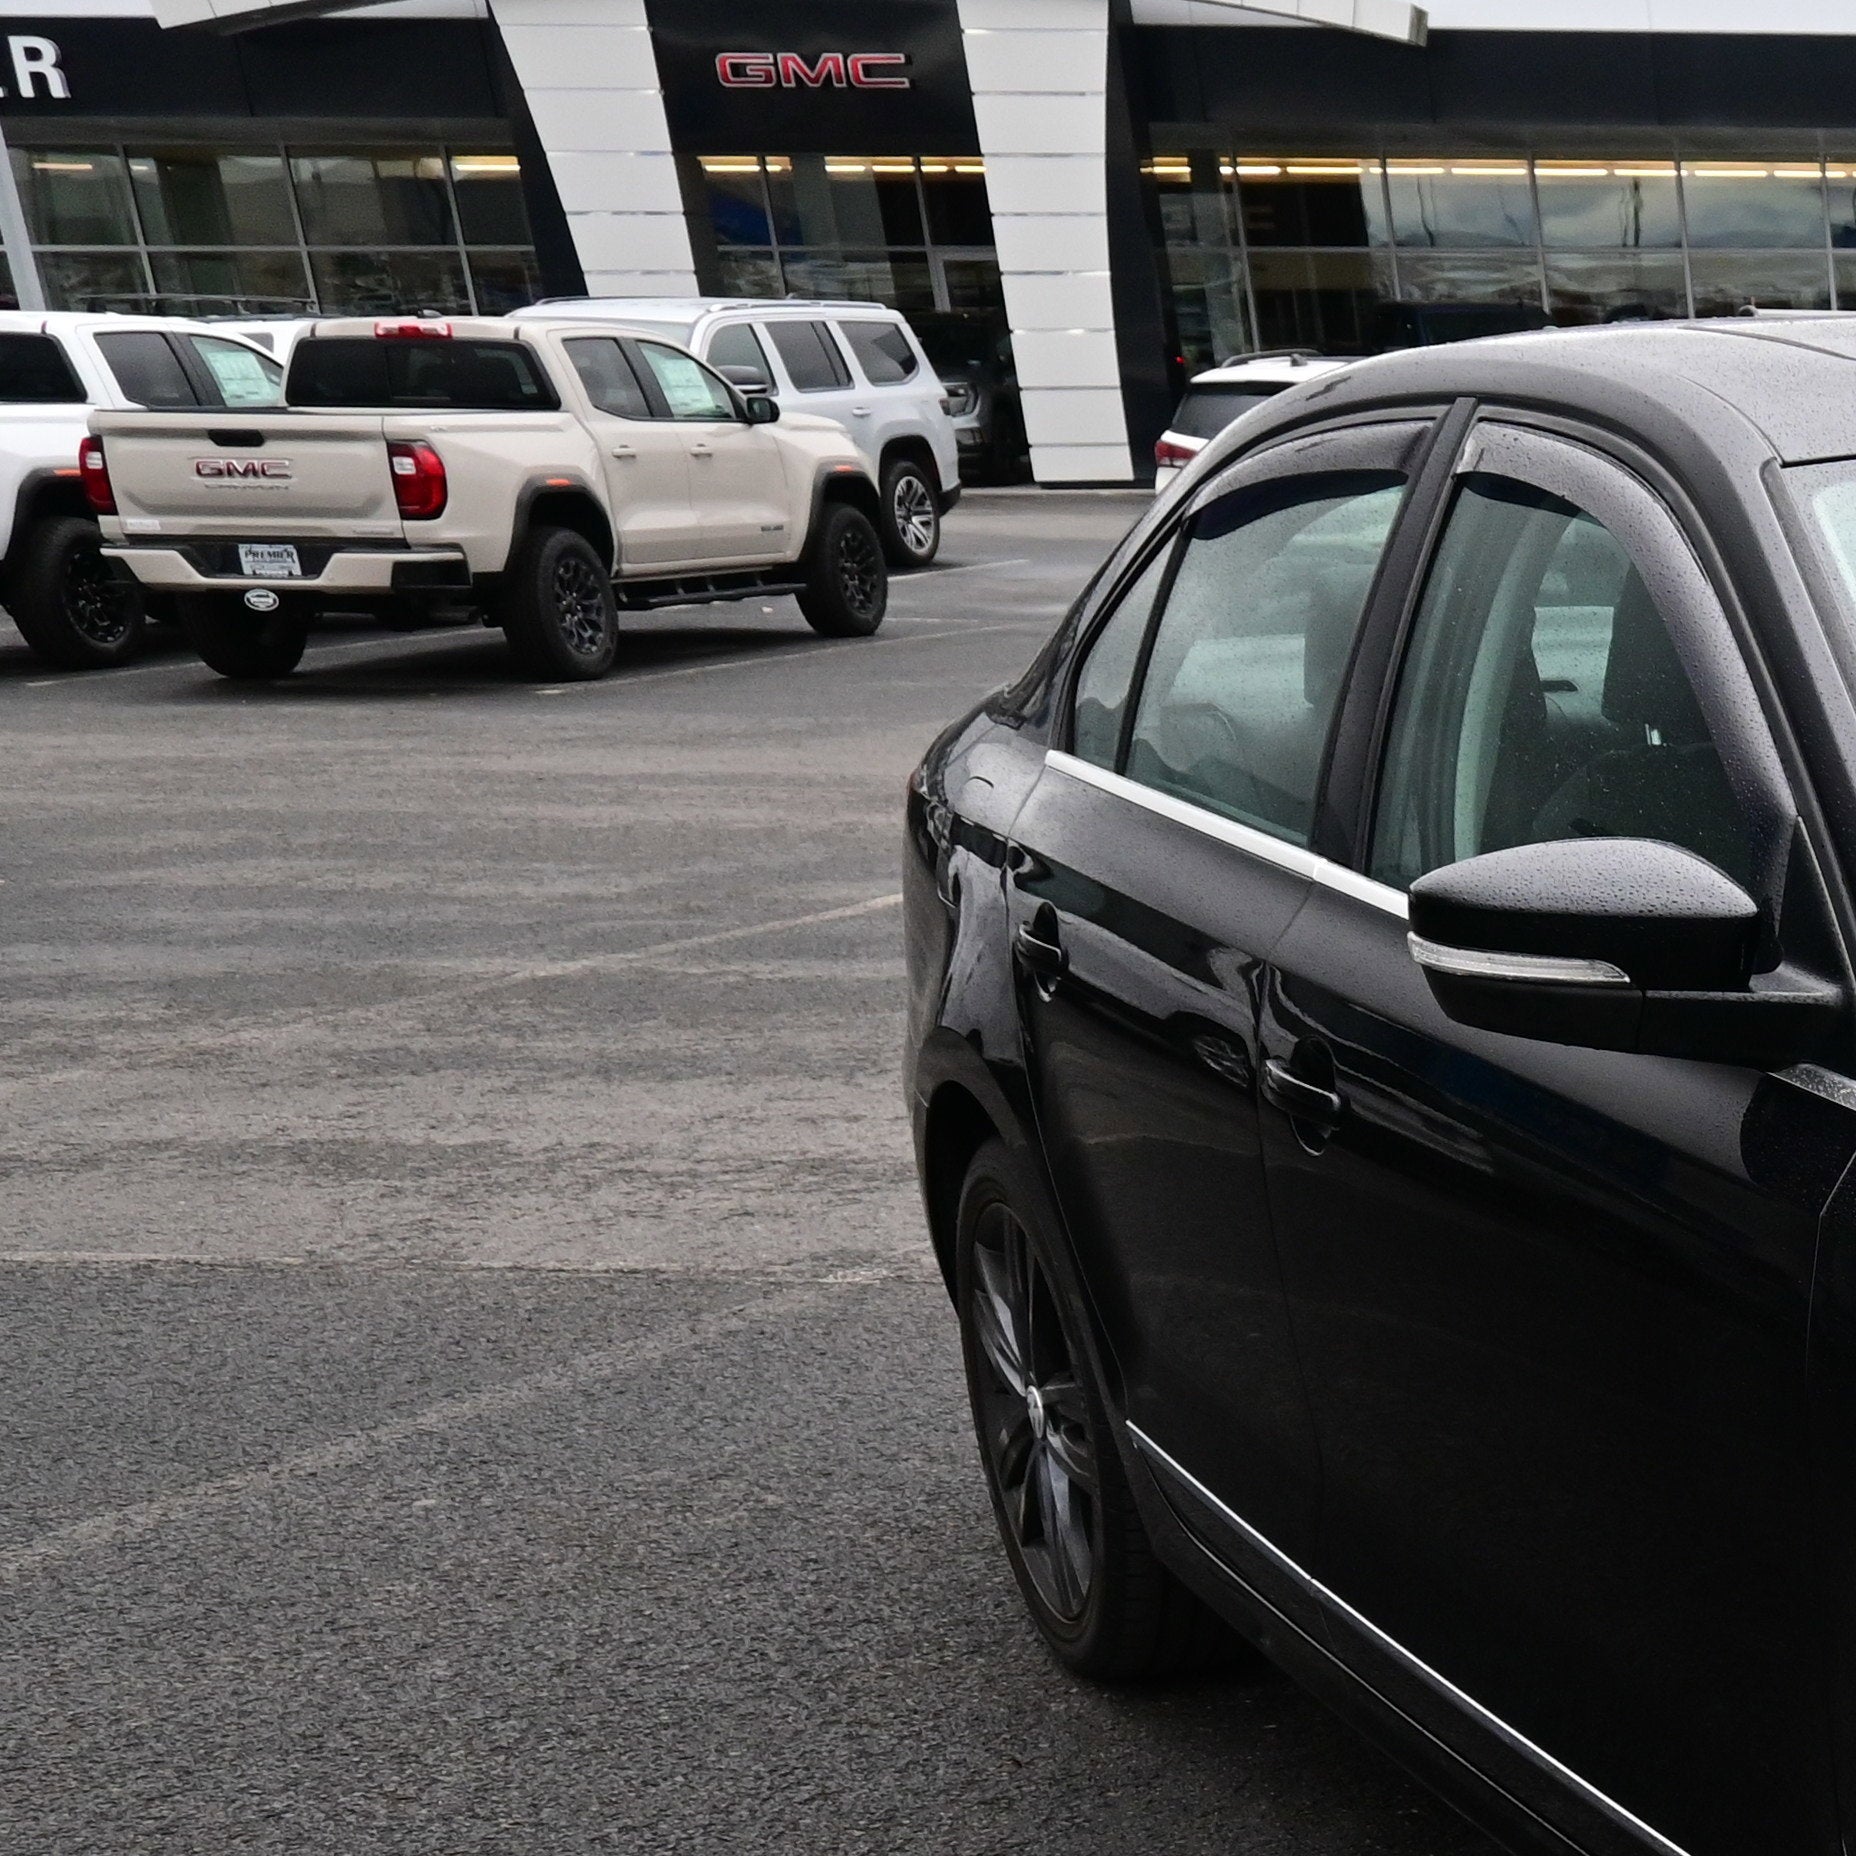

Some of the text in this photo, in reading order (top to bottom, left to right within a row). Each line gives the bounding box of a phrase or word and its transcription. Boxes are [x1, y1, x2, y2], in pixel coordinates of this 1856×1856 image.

[0, 36, 71, 98] R
[715, 52, 911, 88] GMC
[195, 459, 293, 479] GMC
